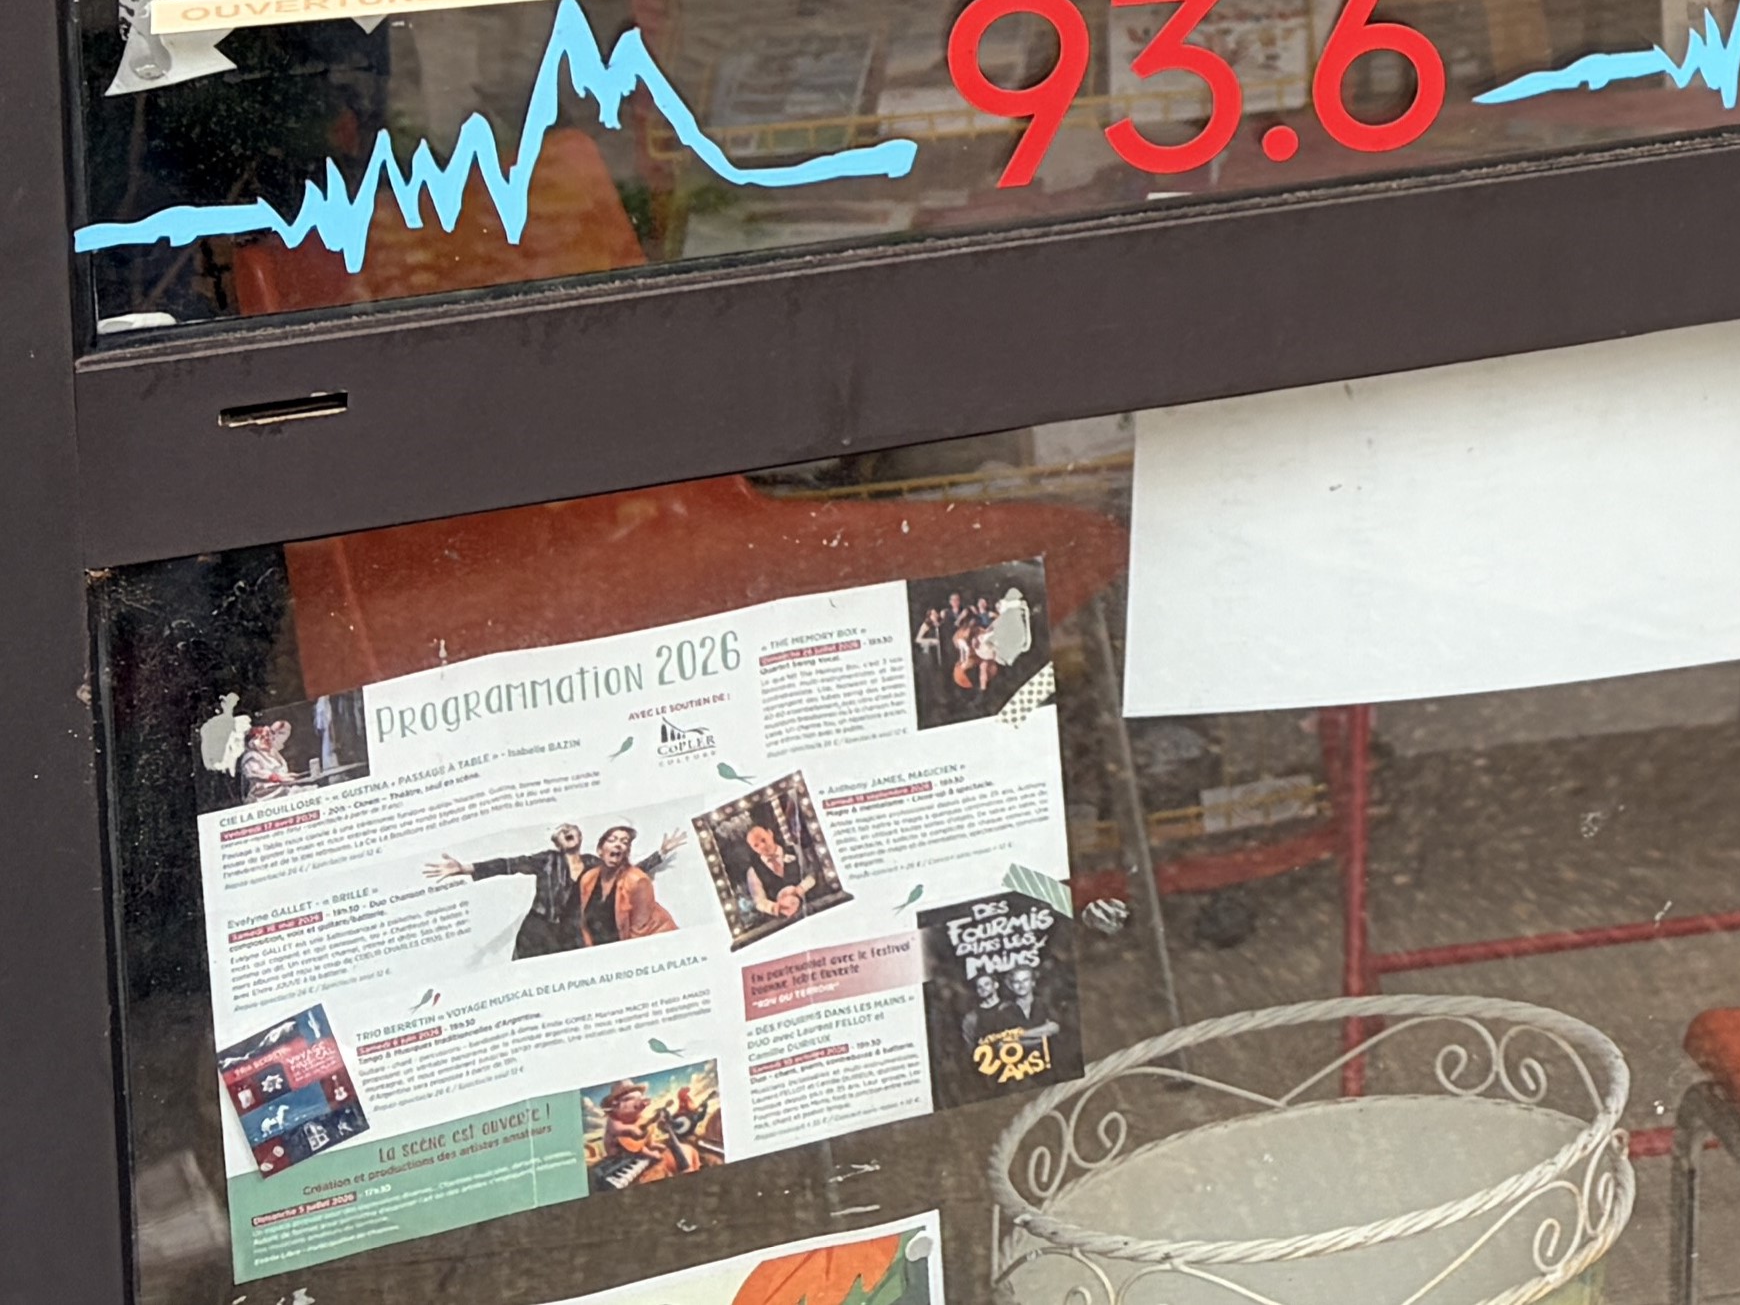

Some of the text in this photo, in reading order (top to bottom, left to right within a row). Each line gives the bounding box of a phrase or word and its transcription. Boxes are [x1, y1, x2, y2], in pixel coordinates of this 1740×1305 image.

[770, 627, 858, 649] THE MEMORY BOX
[375, 630, 741, 744] Programmation 2026
[628, 692, 725, 721] AVEC LE SOUTIEN DE
[219, 815, 237, 828] CIE
[239, 812, 254, 824] LA
[256, 795, 322, 820] BOUILLOIRE
[341, 780, 389, 800] GUSTINA
[397, 765, 446, 786] PASSAGE
[457, 753, 489, 770] TABLE
[507, 745, 546, 758] Isabelle
[547, 739, 581, 752] BAZIN
[827, 764, 958, 795] Anthony JAMES, MAGICIEN
[227, 887, 369, 930] Evelyne GALLET BRILLE
[971, 900, 1009, 921] DES
[356, 955, 699, 1042] TRIO BERRETIN VOYAGE MUSICAL DE LA PUNA AU RIO DE LA PLATA
[754, 995, 906, 1036] DES FOURMIS DANS LES MAINS
[746, 1011, 885, 1050] DUO avec Laurent FELLOT et
[747, 1034, 831, 1062] Camille DURIEUX
[974, 1040, 1027, 1076] 20
[378, 1108, 540, 1164] La scène est ouverte
[302, 1124, 552, 1196] Création et productions des artistes amateurs
